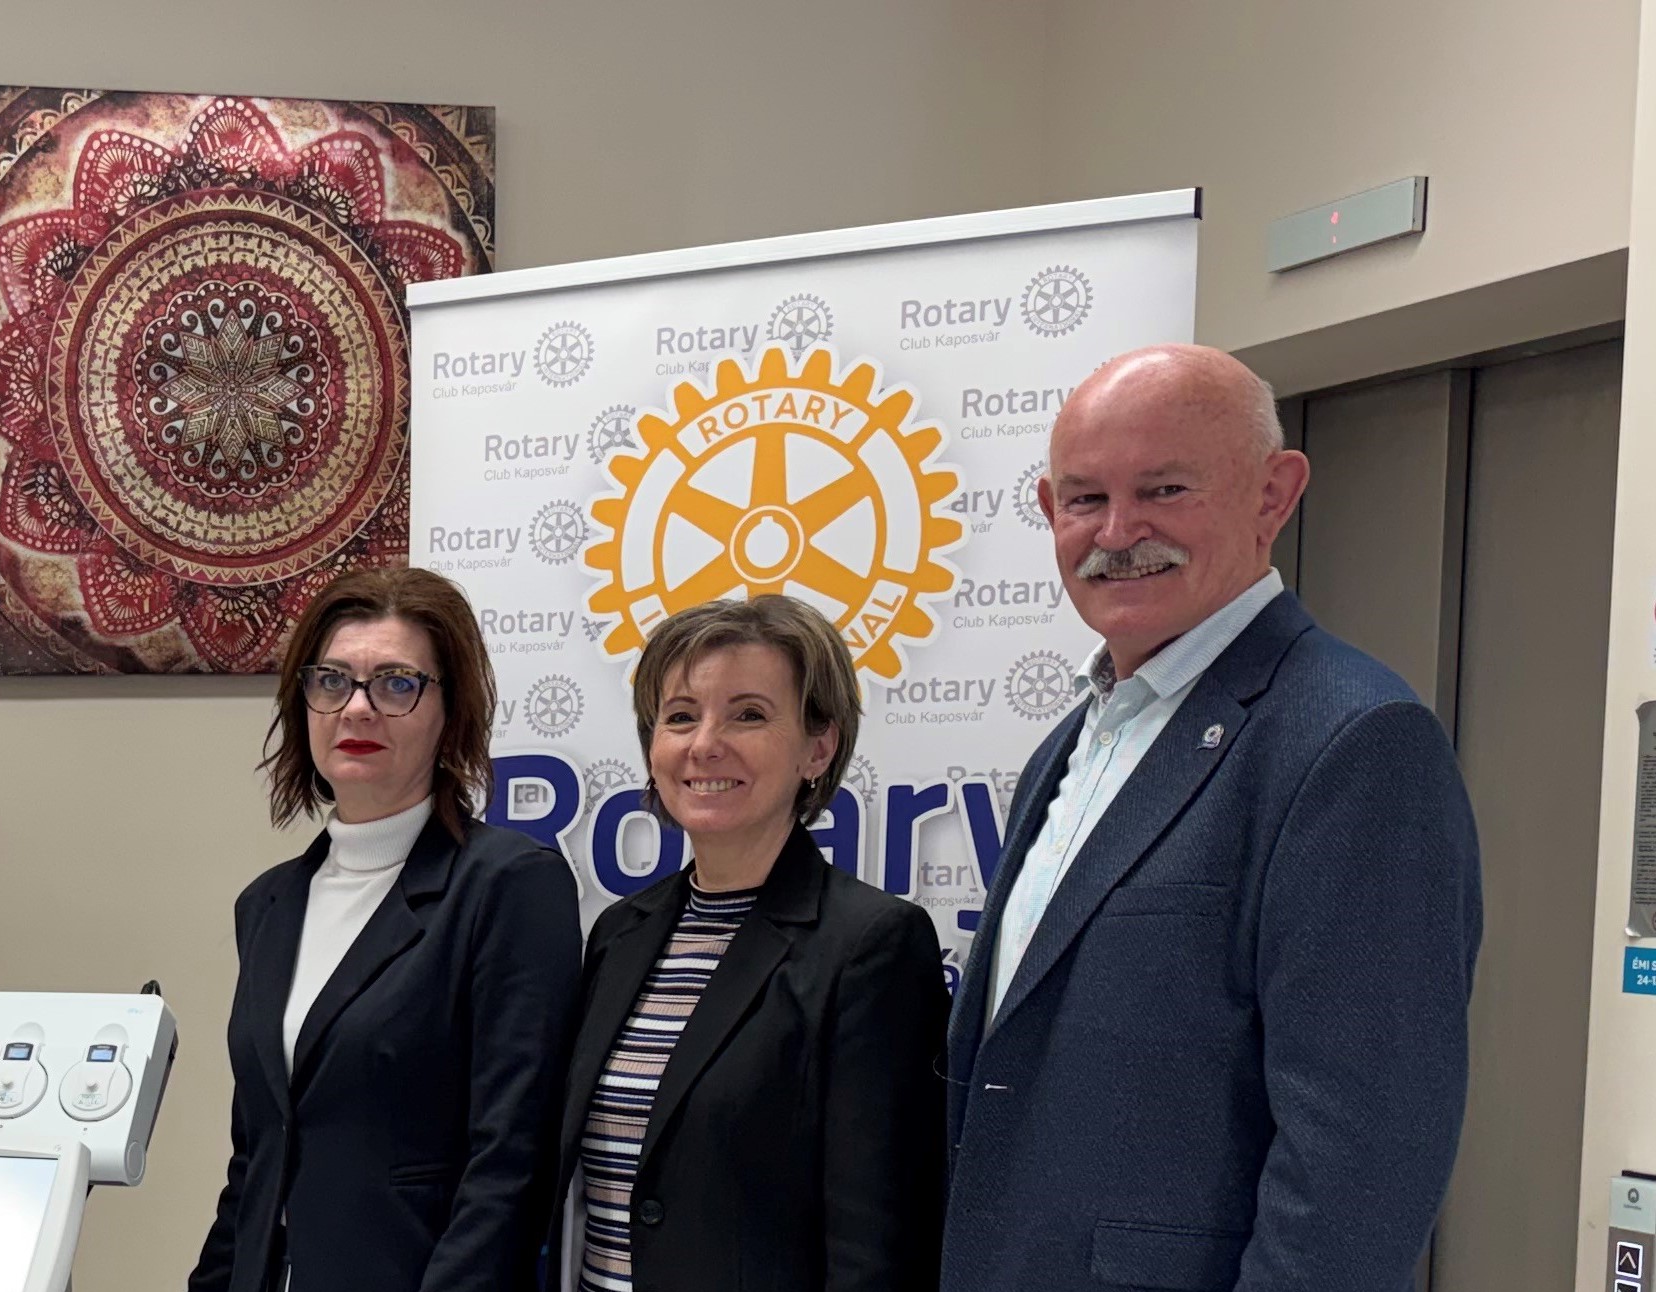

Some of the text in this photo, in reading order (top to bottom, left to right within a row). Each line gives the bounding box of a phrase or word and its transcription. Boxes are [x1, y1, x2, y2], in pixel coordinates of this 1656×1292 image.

[900, 297, 1012, 330] Rotary
[656, 324, 759, 355] Rotary
[900, 331, 1001, 351] Club Kaposvár
[432, 350, 526, 380] Rotary
[655, 362, 685, 376] Club
[432, 380, 518, 399] Club Kaposvár
[696, 392, 855, 445] ROTARY
[960, 422, 1051, 440] Club Kaposv
[484, 433, 580, 461] Rotary
[484, 464, 569, 481] Club Kaposvár
[950, 488, 1004, 517] ary
[429, 527, 521, 553] Rotary
[429, 557, 512, 571] Club Kaposvár
[953, 578, 1064, 609] Rotary
[480, 609, 575, 636] Rotary
[953, 612, 1055, 629] Club Kaposvár
[509, 640, 565, 655] Kaposvár
[886, 677, 996, 707] Rotary
[885, 710, 984, 726] Club Kaposvár
[1632, 957, 1649, 970] ÉMI
